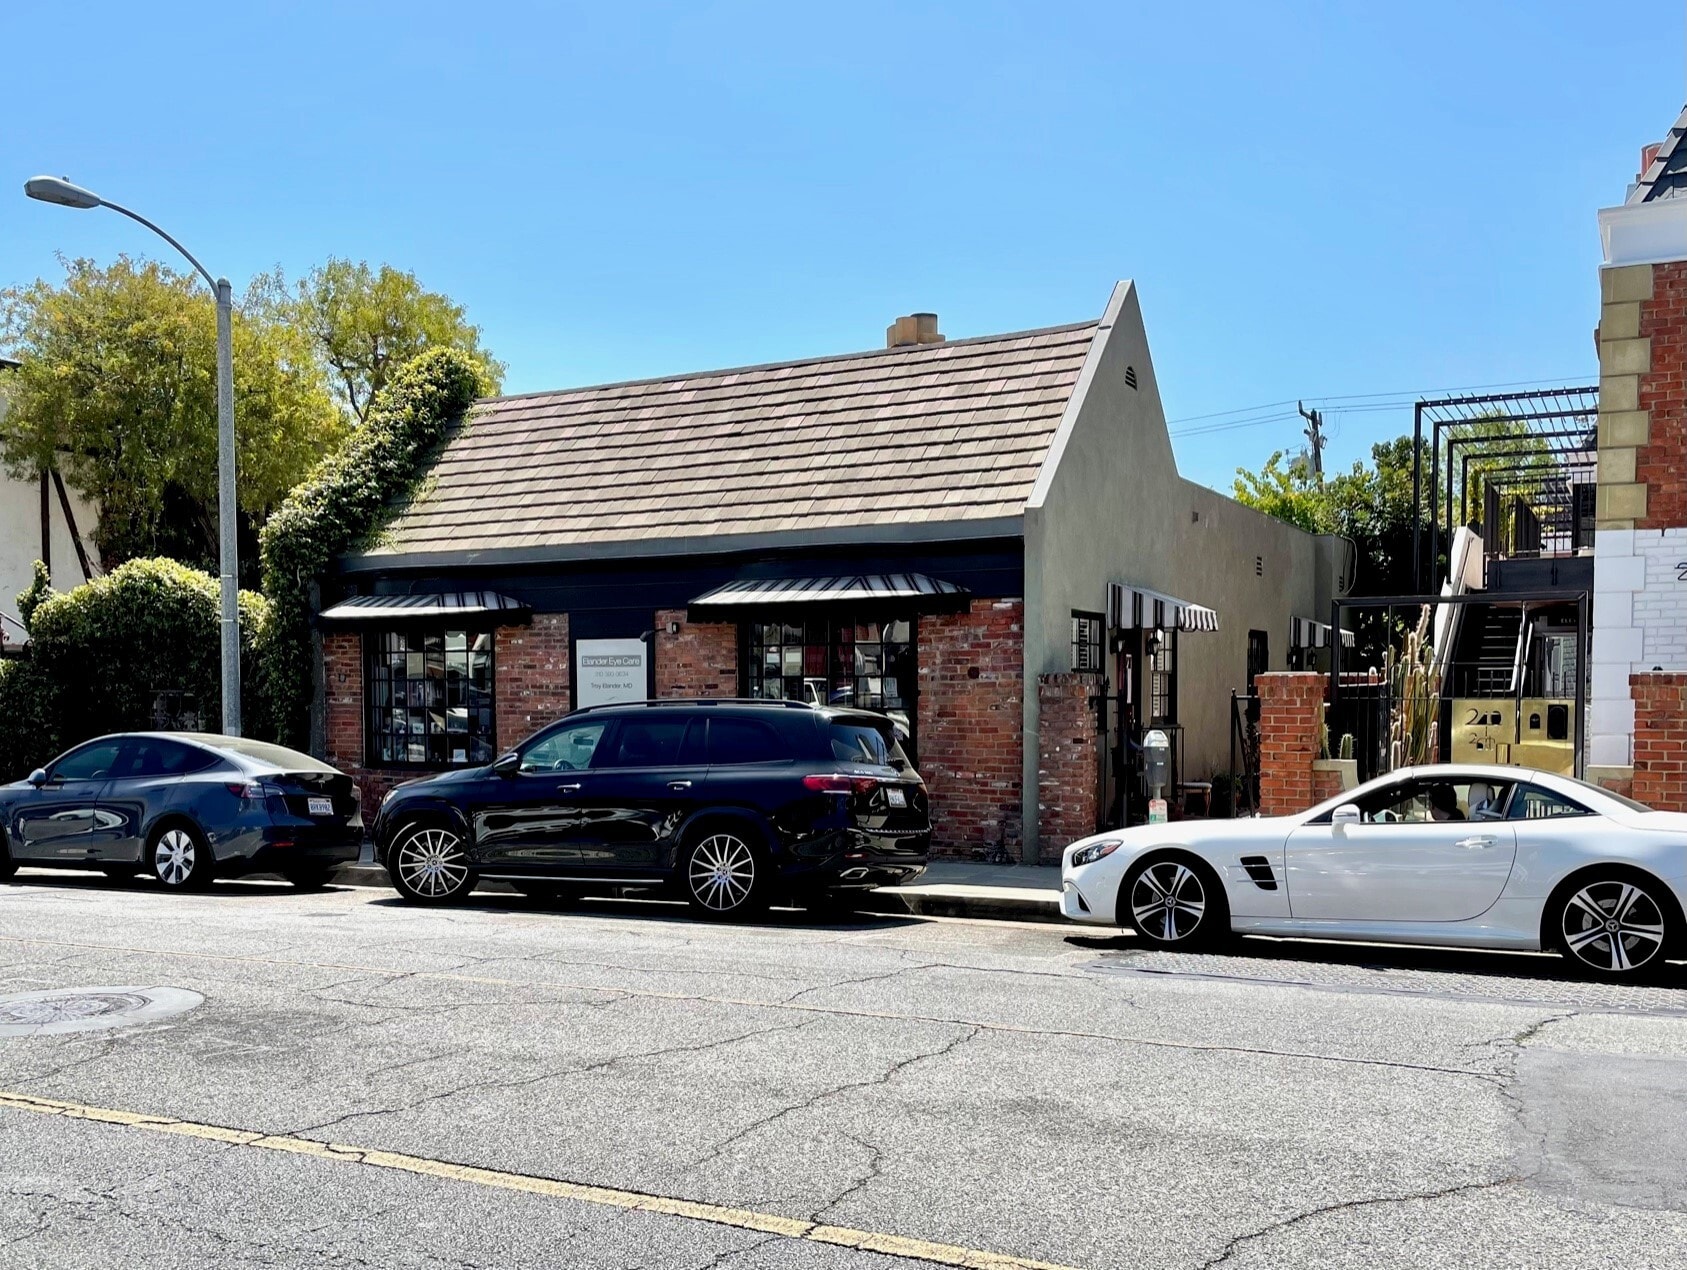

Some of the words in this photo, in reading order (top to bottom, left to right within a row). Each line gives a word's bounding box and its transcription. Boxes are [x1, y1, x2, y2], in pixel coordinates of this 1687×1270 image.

[609, 657, 622, 666] Eye
[623, 657, 640, 665] Care
[591, 682, 601, 690] Troy
